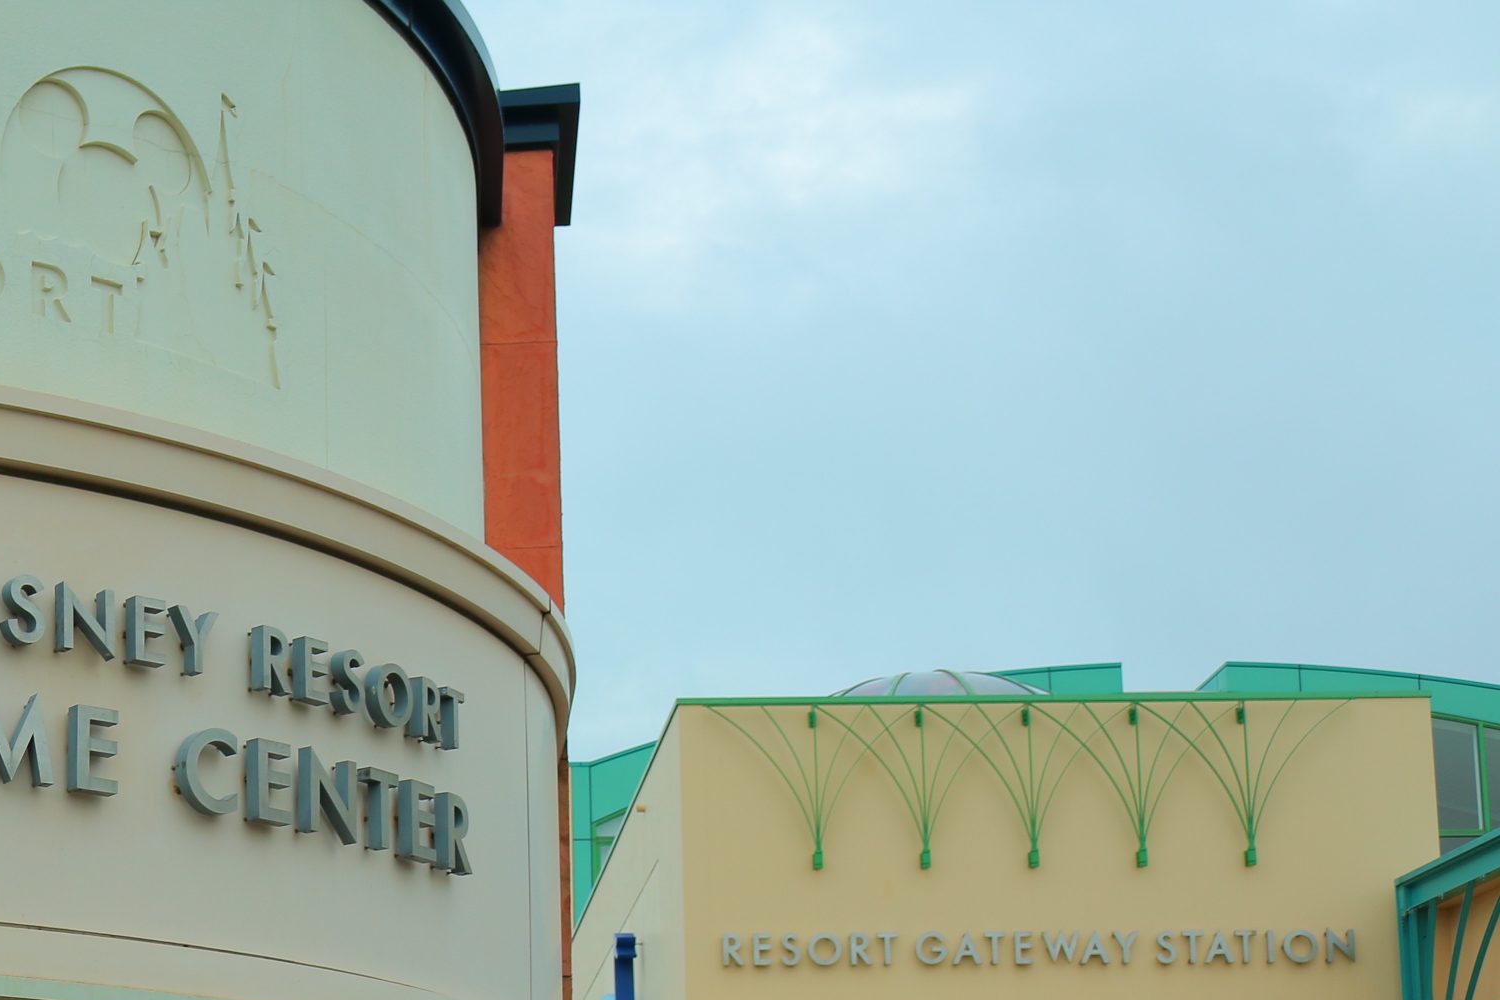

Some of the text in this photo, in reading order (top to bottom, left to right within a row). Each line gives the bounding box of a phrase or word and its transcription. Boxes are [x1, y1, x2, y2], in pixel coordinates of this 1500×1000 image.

[247, 624, 466, 750] RESORT
[171, 727, 475, 876] CENTER
[720, 927, 1358, 968] RESORT GATEWAY STATION
